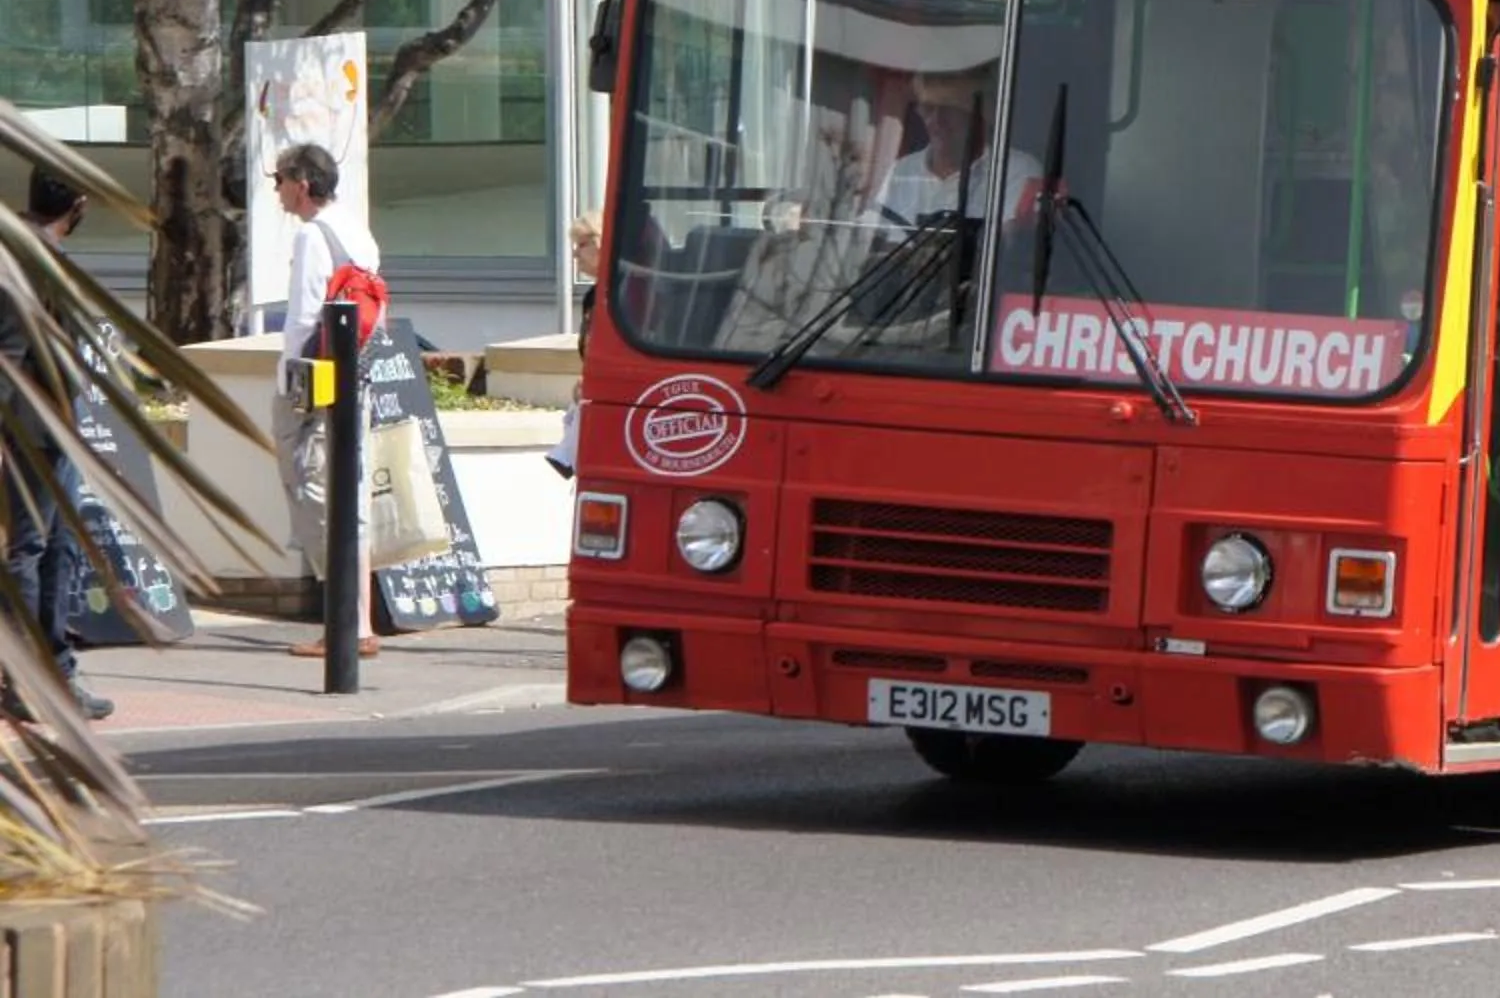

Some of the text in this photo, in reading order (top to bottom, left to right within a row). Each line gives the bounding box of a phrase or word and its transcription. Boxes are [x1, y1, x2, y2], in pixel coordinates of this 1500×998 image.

[1000, 308, 1387, 391] CHRISTCHURCH
[651, 413, 718, 438] OFFICIAL
[889, 685, 1028, 728] E312 MSG
